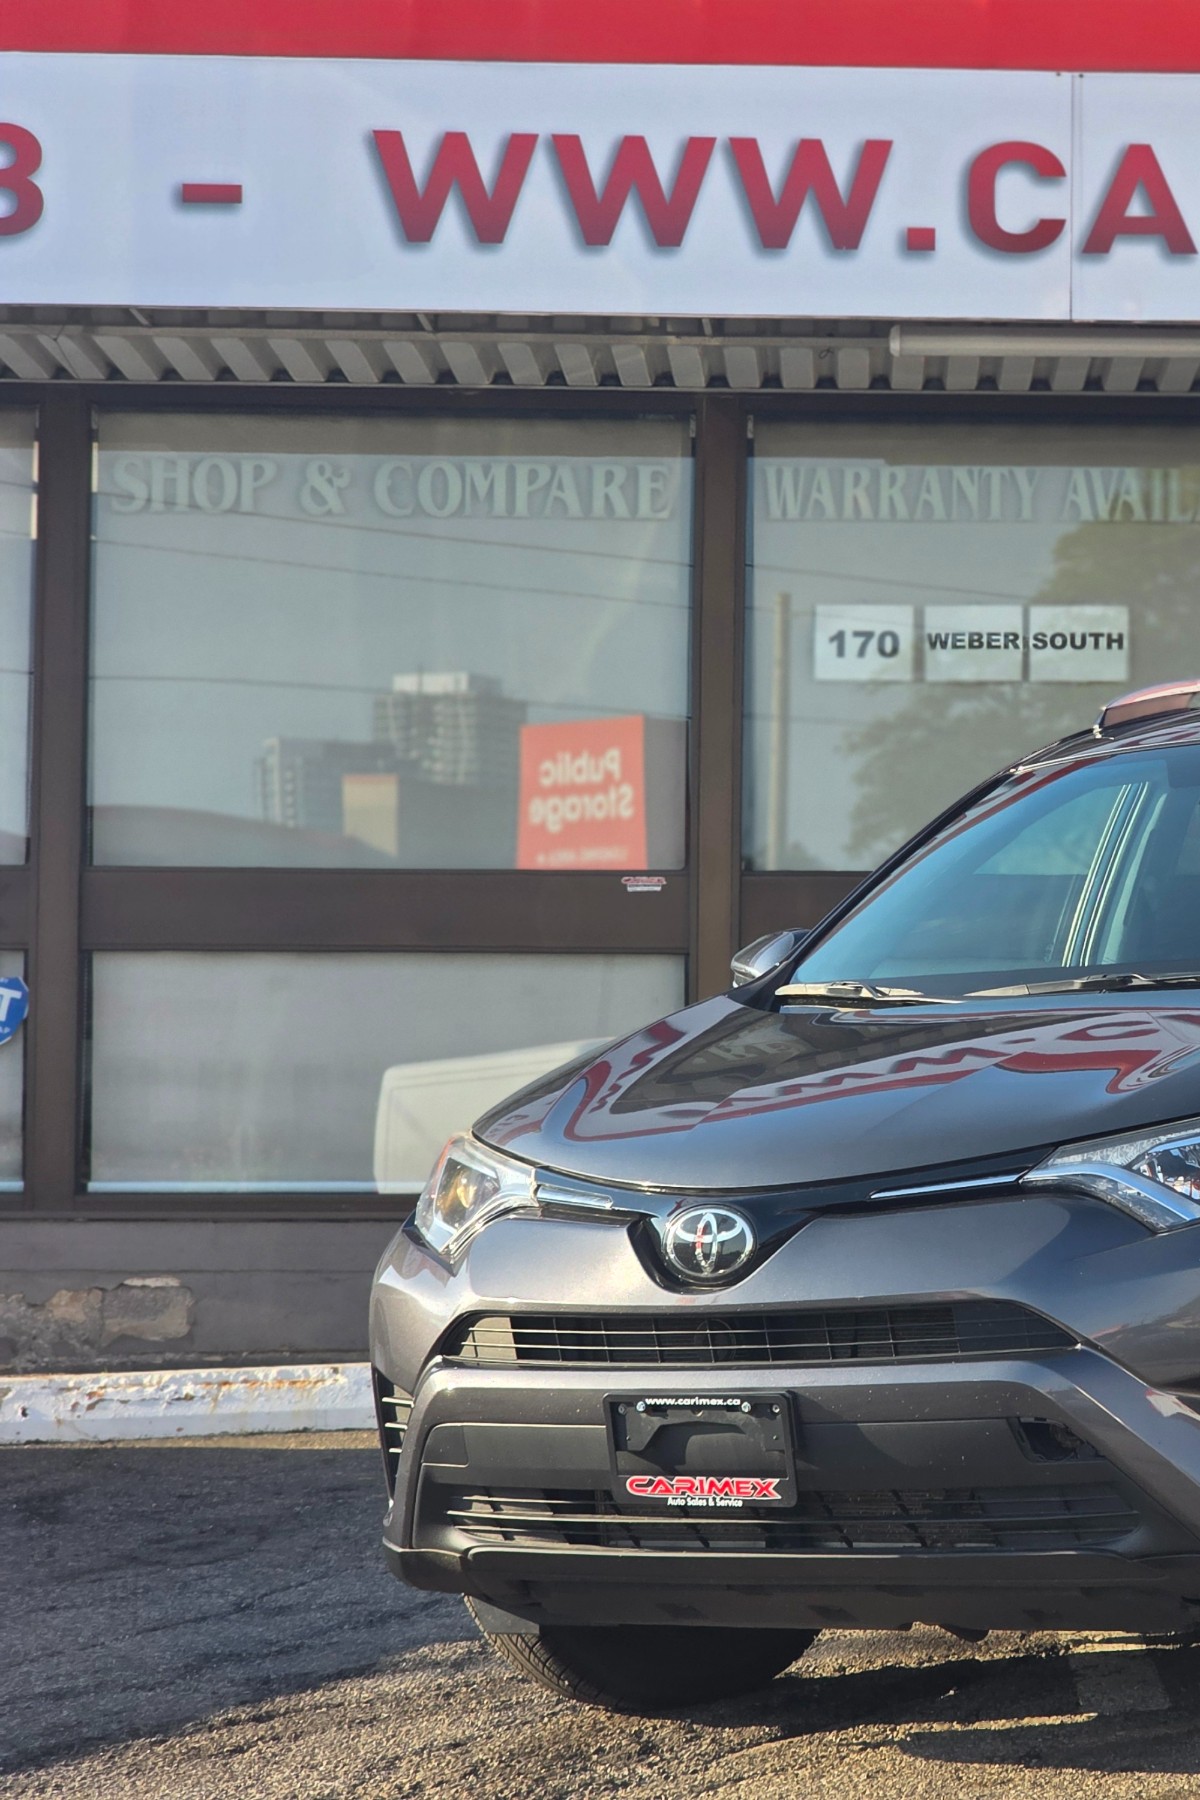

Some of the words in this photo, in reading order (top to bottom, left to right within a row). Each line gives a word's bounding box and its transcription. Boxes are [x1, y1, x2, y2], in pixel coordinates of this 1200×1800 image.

[111, 456, 277, 514] SHOP
[302, 461, 353, 517] &
[374, 460, 674, 521] COMPARE
[764, 464, 1041, 523] WARRANTY
[828, 630, 899, 659] 170
[927, 631, 1021, 651] WEBER
[1031, 631, 1125, 652] SOUTH
[645, 1396, 741, 1406] www.carimex.ca
[626, 1475, 782, 1500] CARIMEX
[667, 1496, 686, 1507] Auto
[686, 1496, 708, 1507] Sales
[716, 1497, 743, 1507] Service
